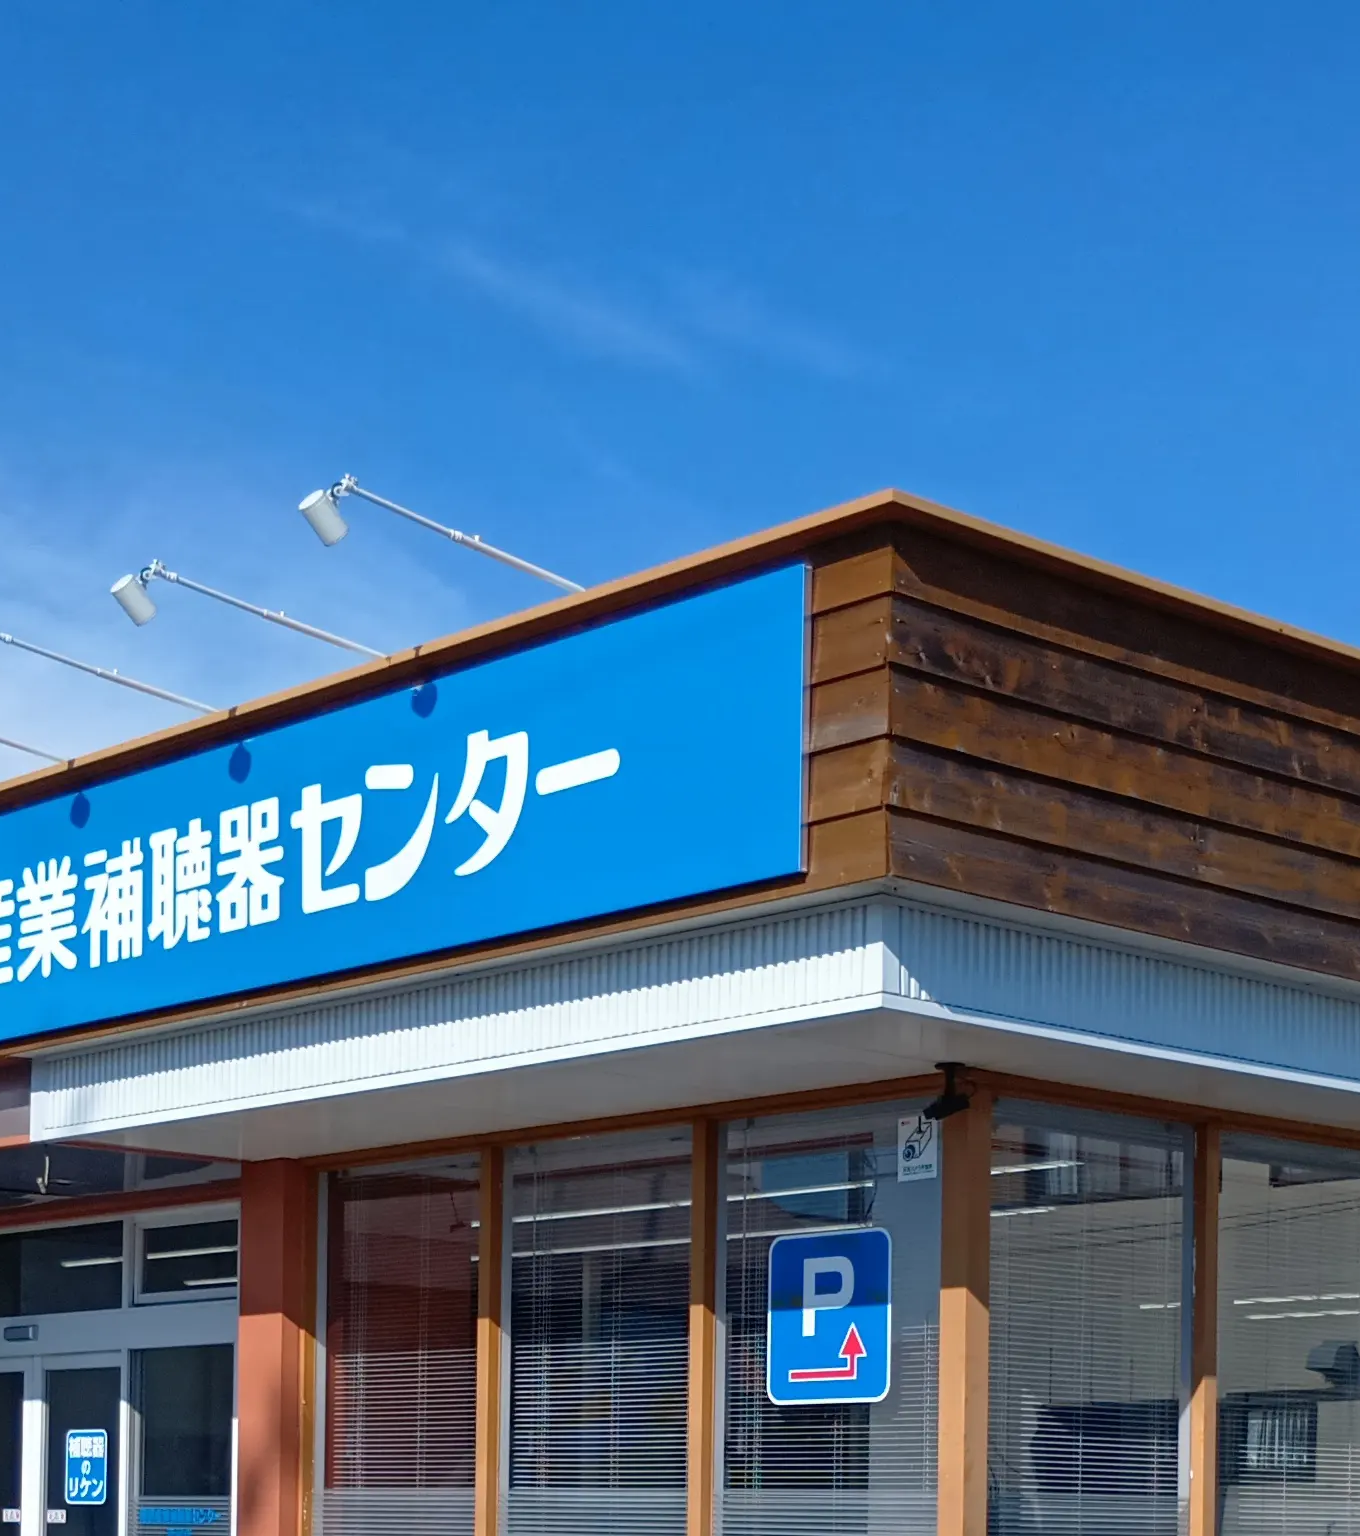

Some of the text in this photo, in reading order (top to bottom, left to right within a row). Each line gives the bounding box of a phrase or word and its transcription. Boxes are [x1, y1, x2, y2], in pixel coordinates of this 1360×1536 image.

[802, 1256, 855, 1337] P
[68, 1436, 105, 1458] 補聴器
[81, 1460, 91, 1475] の
[69, 1477, 103, 1497] リケン
